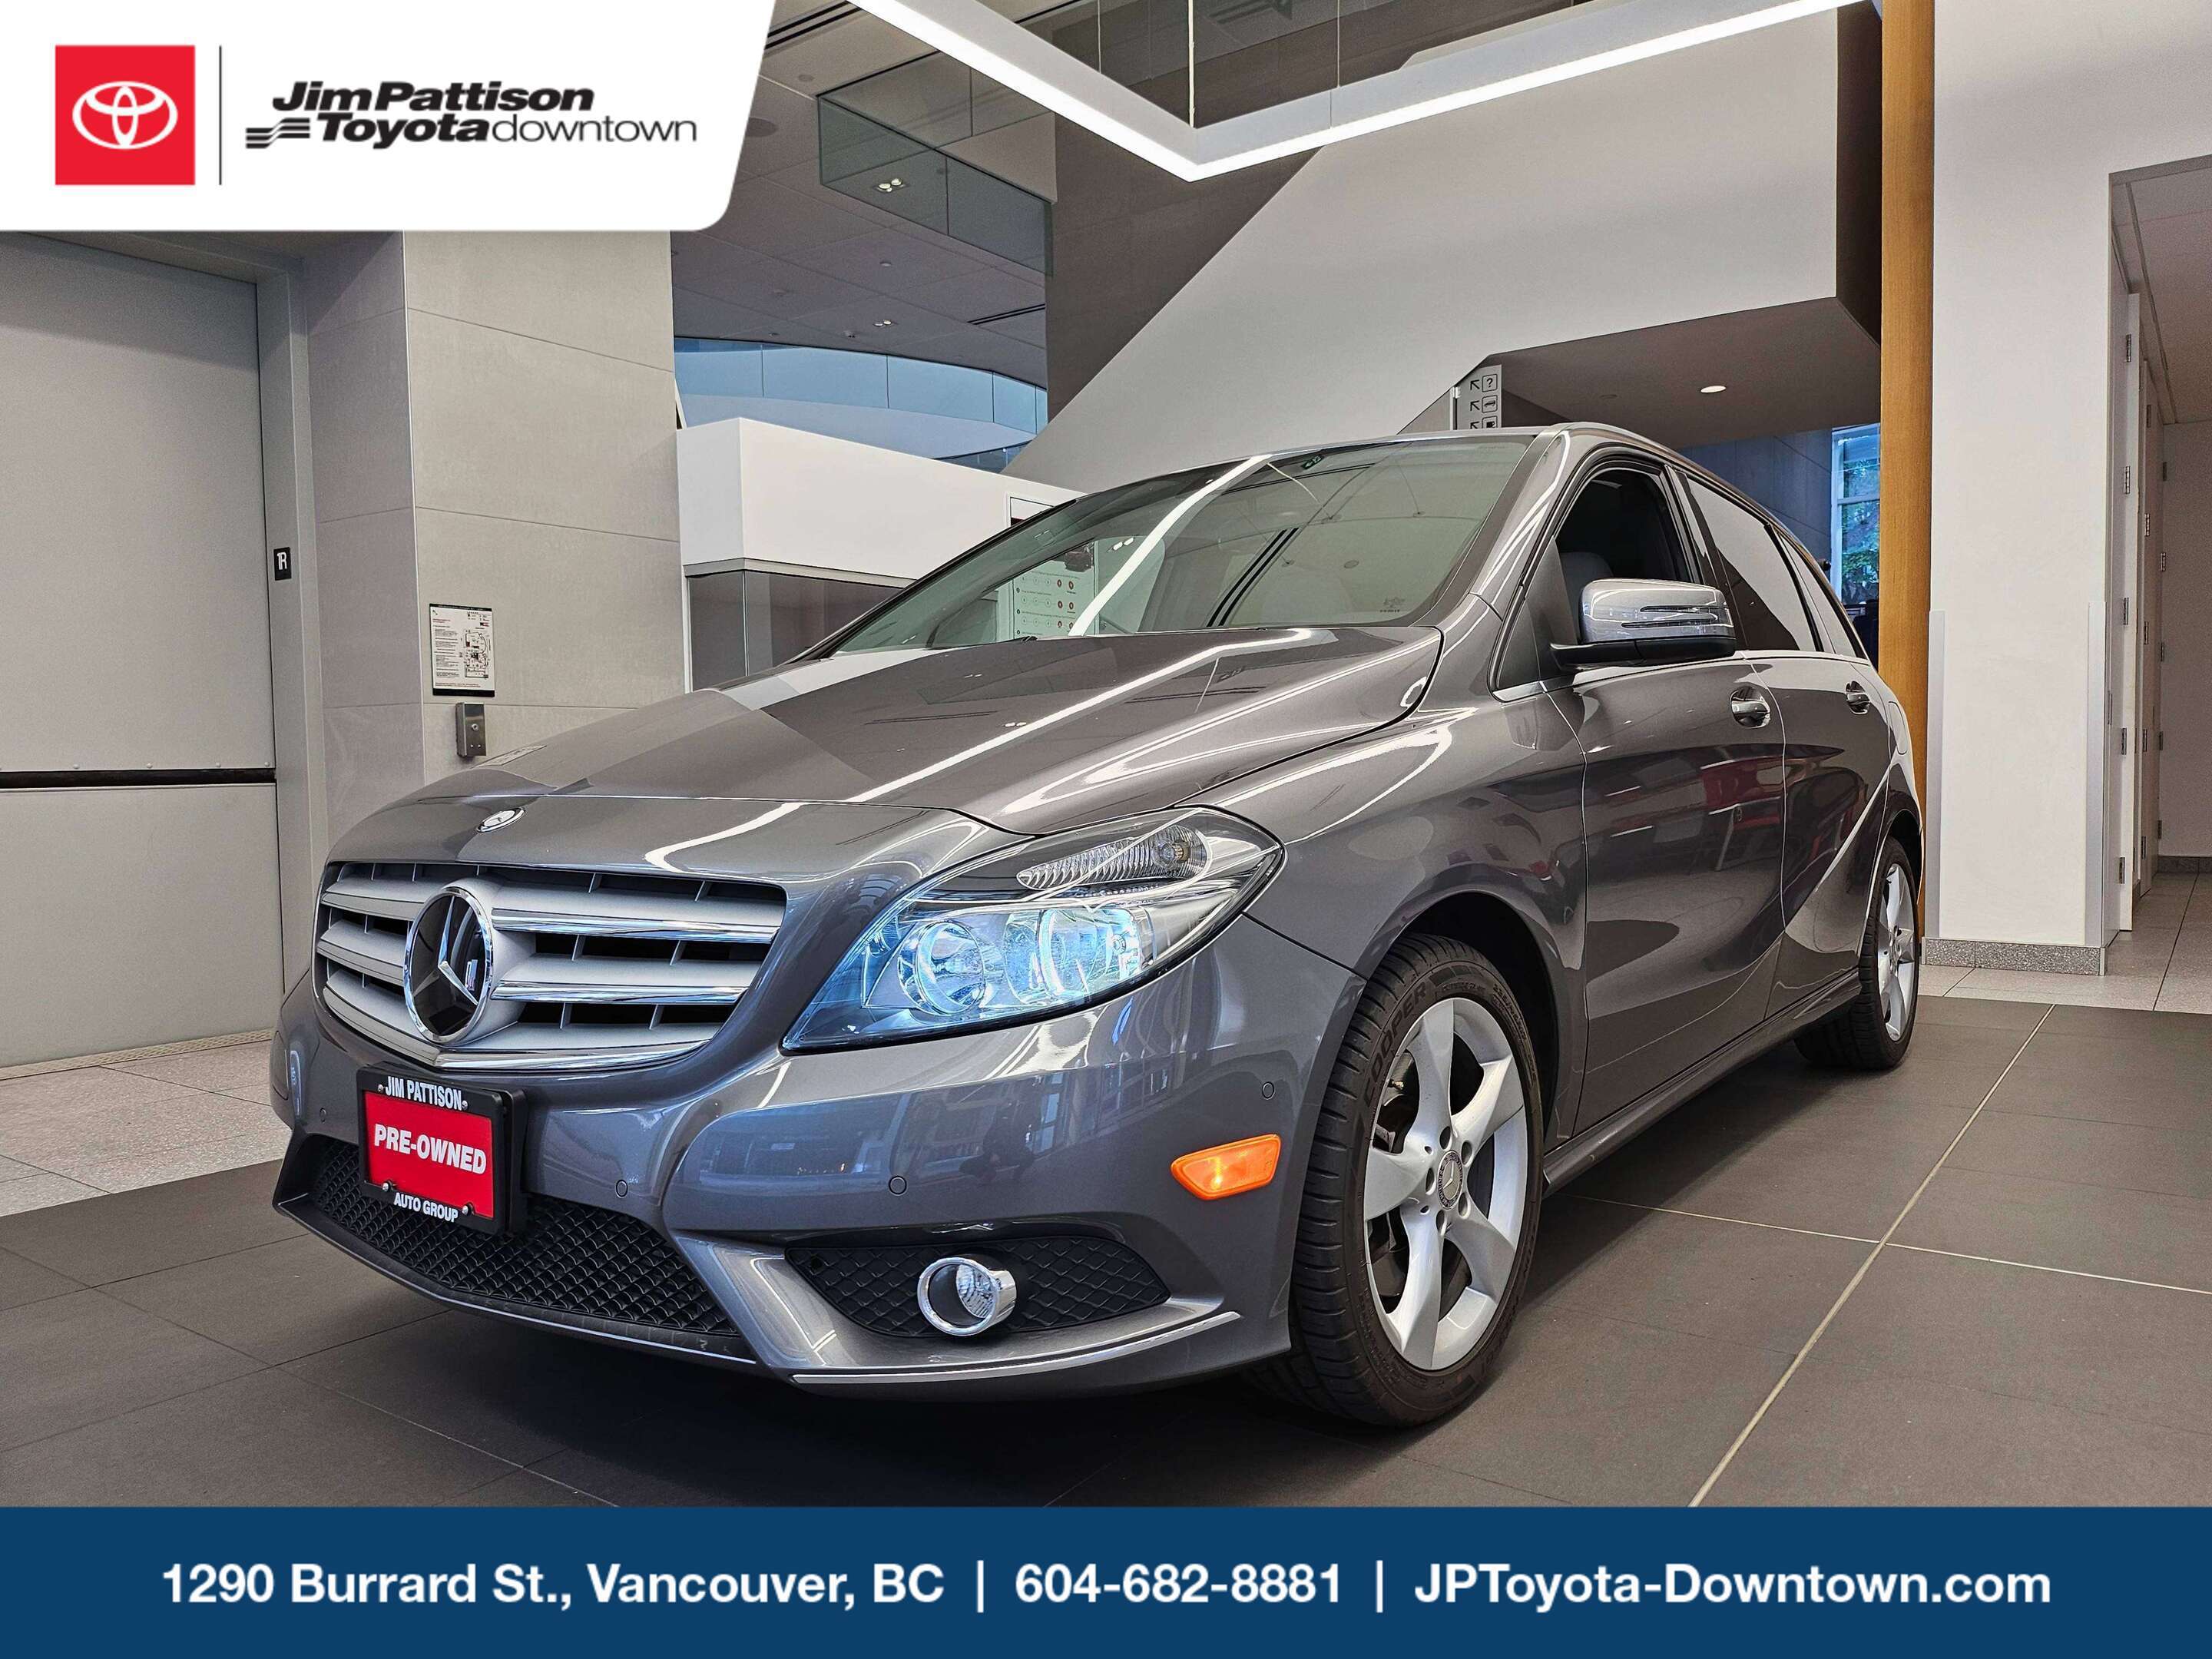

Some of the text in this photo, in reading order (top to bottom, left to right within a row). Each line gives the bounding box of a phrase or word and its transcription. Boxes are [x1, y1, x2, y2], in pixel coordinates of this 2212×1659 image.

[385, 1075, 462, 1111] JIM PATTISON
[373, 1123, 487, 1174] PRE-OWNED
[393, 1191, 459, 1223] AUTO GROUP
